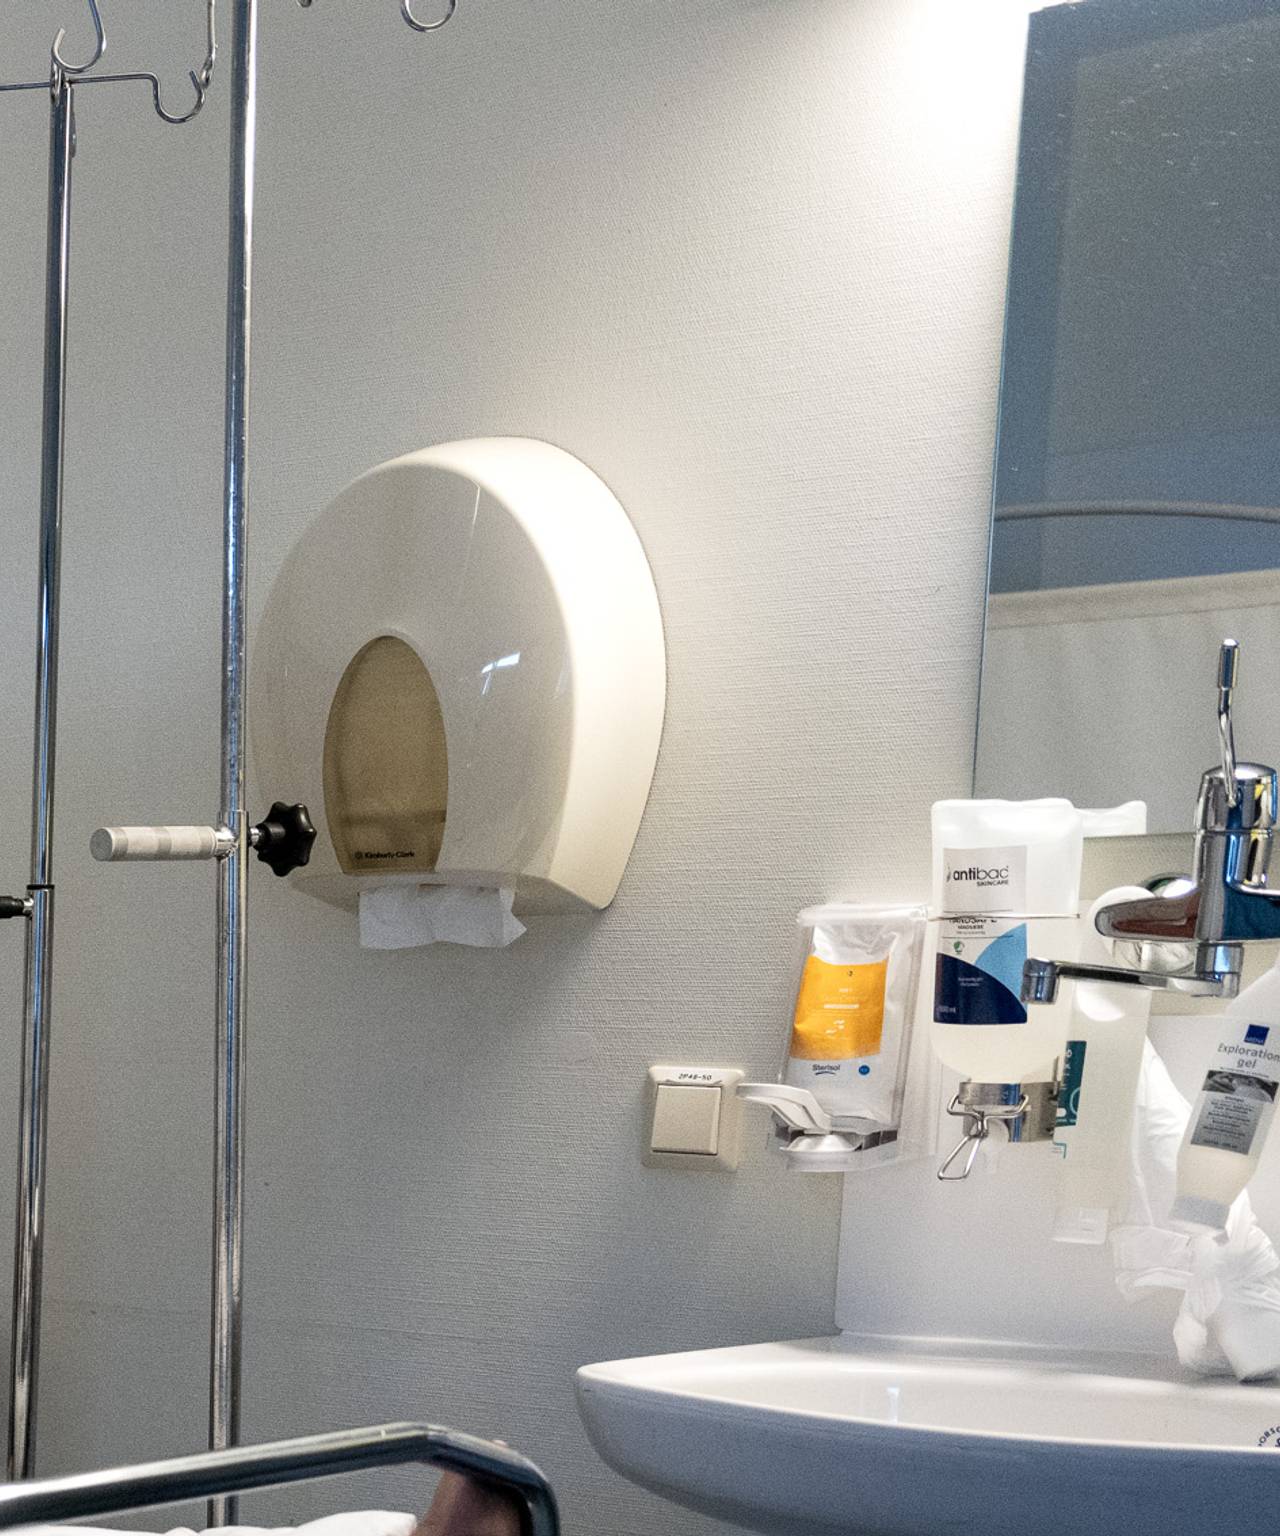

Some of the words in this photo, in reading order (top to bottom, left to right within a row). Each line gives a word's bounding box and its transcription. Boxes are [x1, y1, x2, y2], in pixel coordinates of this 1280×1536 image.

[953, 866, 1009, 881] antibac
[976, 879, 1009, 887] SKINCARE
[1217, 1043, 1280, 1063] Exploration
[1237, 1058, 1257, 1069] gel
